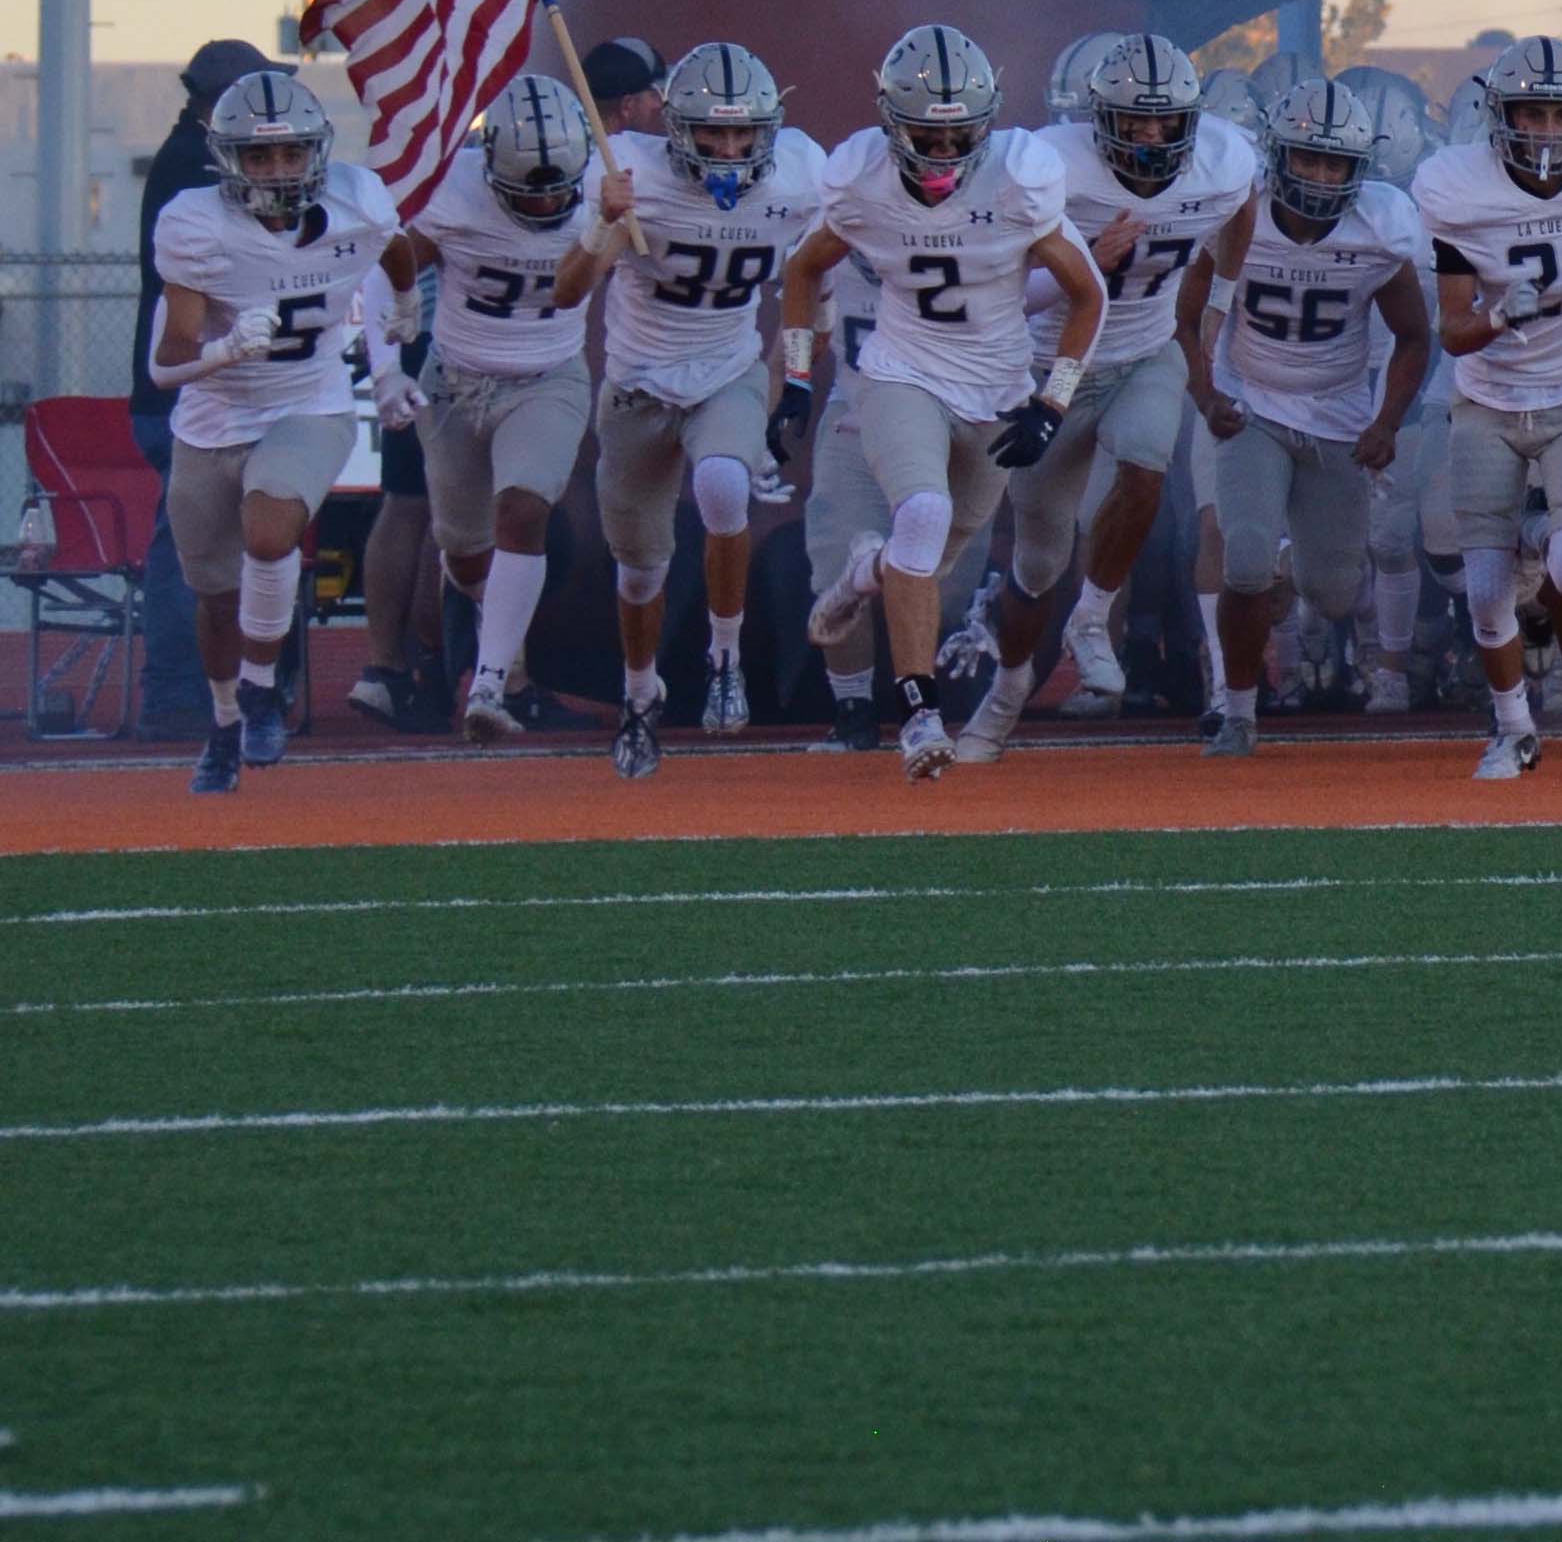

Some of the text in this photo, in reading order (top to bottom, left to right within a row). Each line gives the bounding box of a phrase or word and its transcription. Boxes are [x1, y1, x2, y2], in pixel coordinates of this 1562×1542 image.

[698, 226, 758, 240] LA CUEVA
[1145, 223, 1174, 235] UEVA
[1517, 221, 1533, 237] LA
[902, 234, 964, 248] LA CUEVA
[270, 272, 331, 291] LA CUEVA
[654, 241, 775, 308] 38
[1269, 266, 1328, 283] LA CUEVA
[909, 255, 967, 322] 2
[1244, 280, 1350, 342] 56
[268, 292, 326, 362] 5
